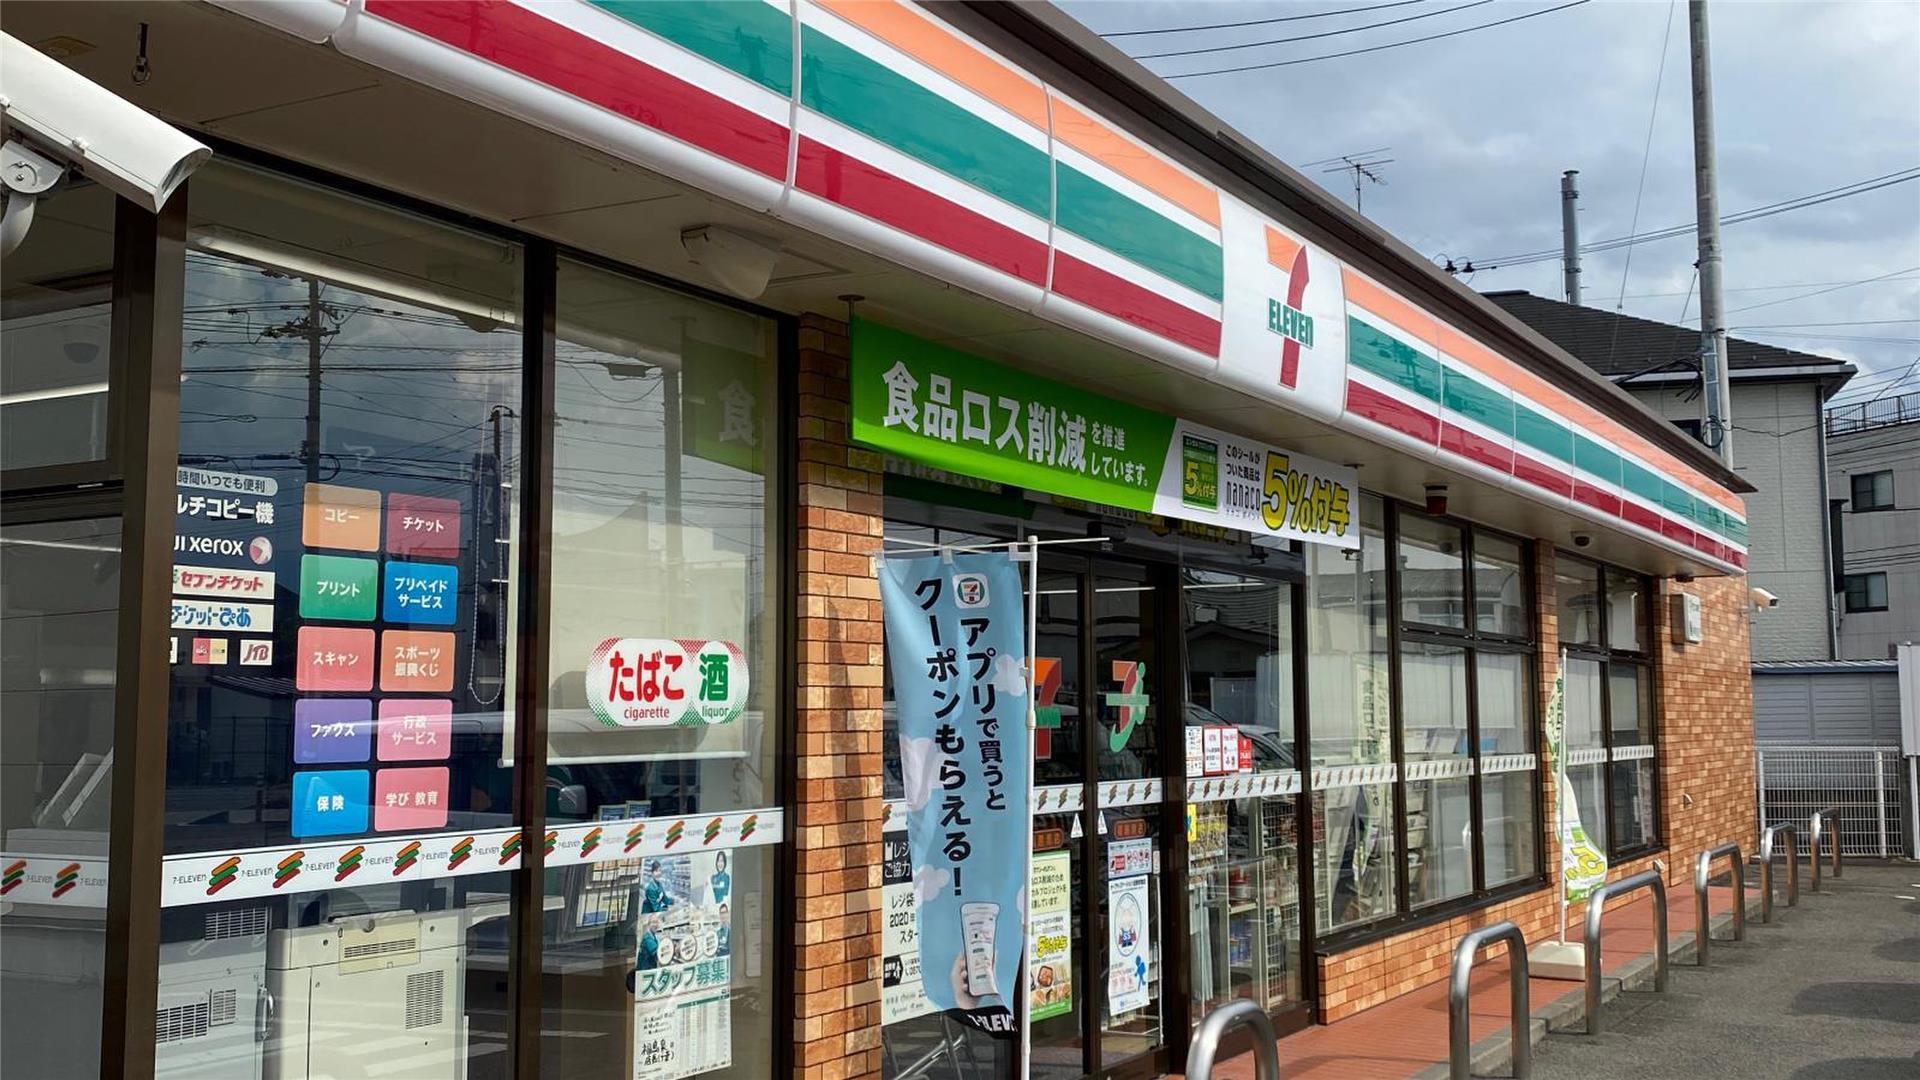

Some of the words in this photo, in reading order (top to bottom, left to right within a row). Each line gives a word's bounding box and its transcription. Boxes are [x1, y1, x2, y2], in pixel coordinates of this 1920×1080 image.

[883, 360, 1086, 472] 食品ロス削減
[1091, 421, 1126, 452] を推進
[1225, 444, 1261, 465] このシールが
[1091, 453, 1149, 487] しています。
[1225, 463, 1261, 482] ついた商品は
[1226, 481, 1261, 511] nanaco
[1261, 450, 1350, 537] 5%付与
[325, 508, 360, 521] コピー
[403, 516, 444, 532] チケット
[189, 536, 244, 556] xerox
[181, 571, 263, 591] セブンチケット
[317, 581, 360, 597] プリント
[394, 577, 448, 592] プリペイド
[398, 595, 443, 610] サービス
[313, 652, 359, 666] スキャン
[395, 646, 441, 660] スポーツ
[609, 650, 685, 703] たばこ
[699, 653, 729, 702] 酒
[624, 705, 670, 721] cigarette
[702, 704, 729, 718] liquor
[960, 617, 1006, 811] アプリで買うと
[392, 732, 437, 746] サービス
[914, 578, 972, 897] クーポンもらえる!
[317, 795, 345, 811] 保険
[884, 860, 911, 880] ご協力
